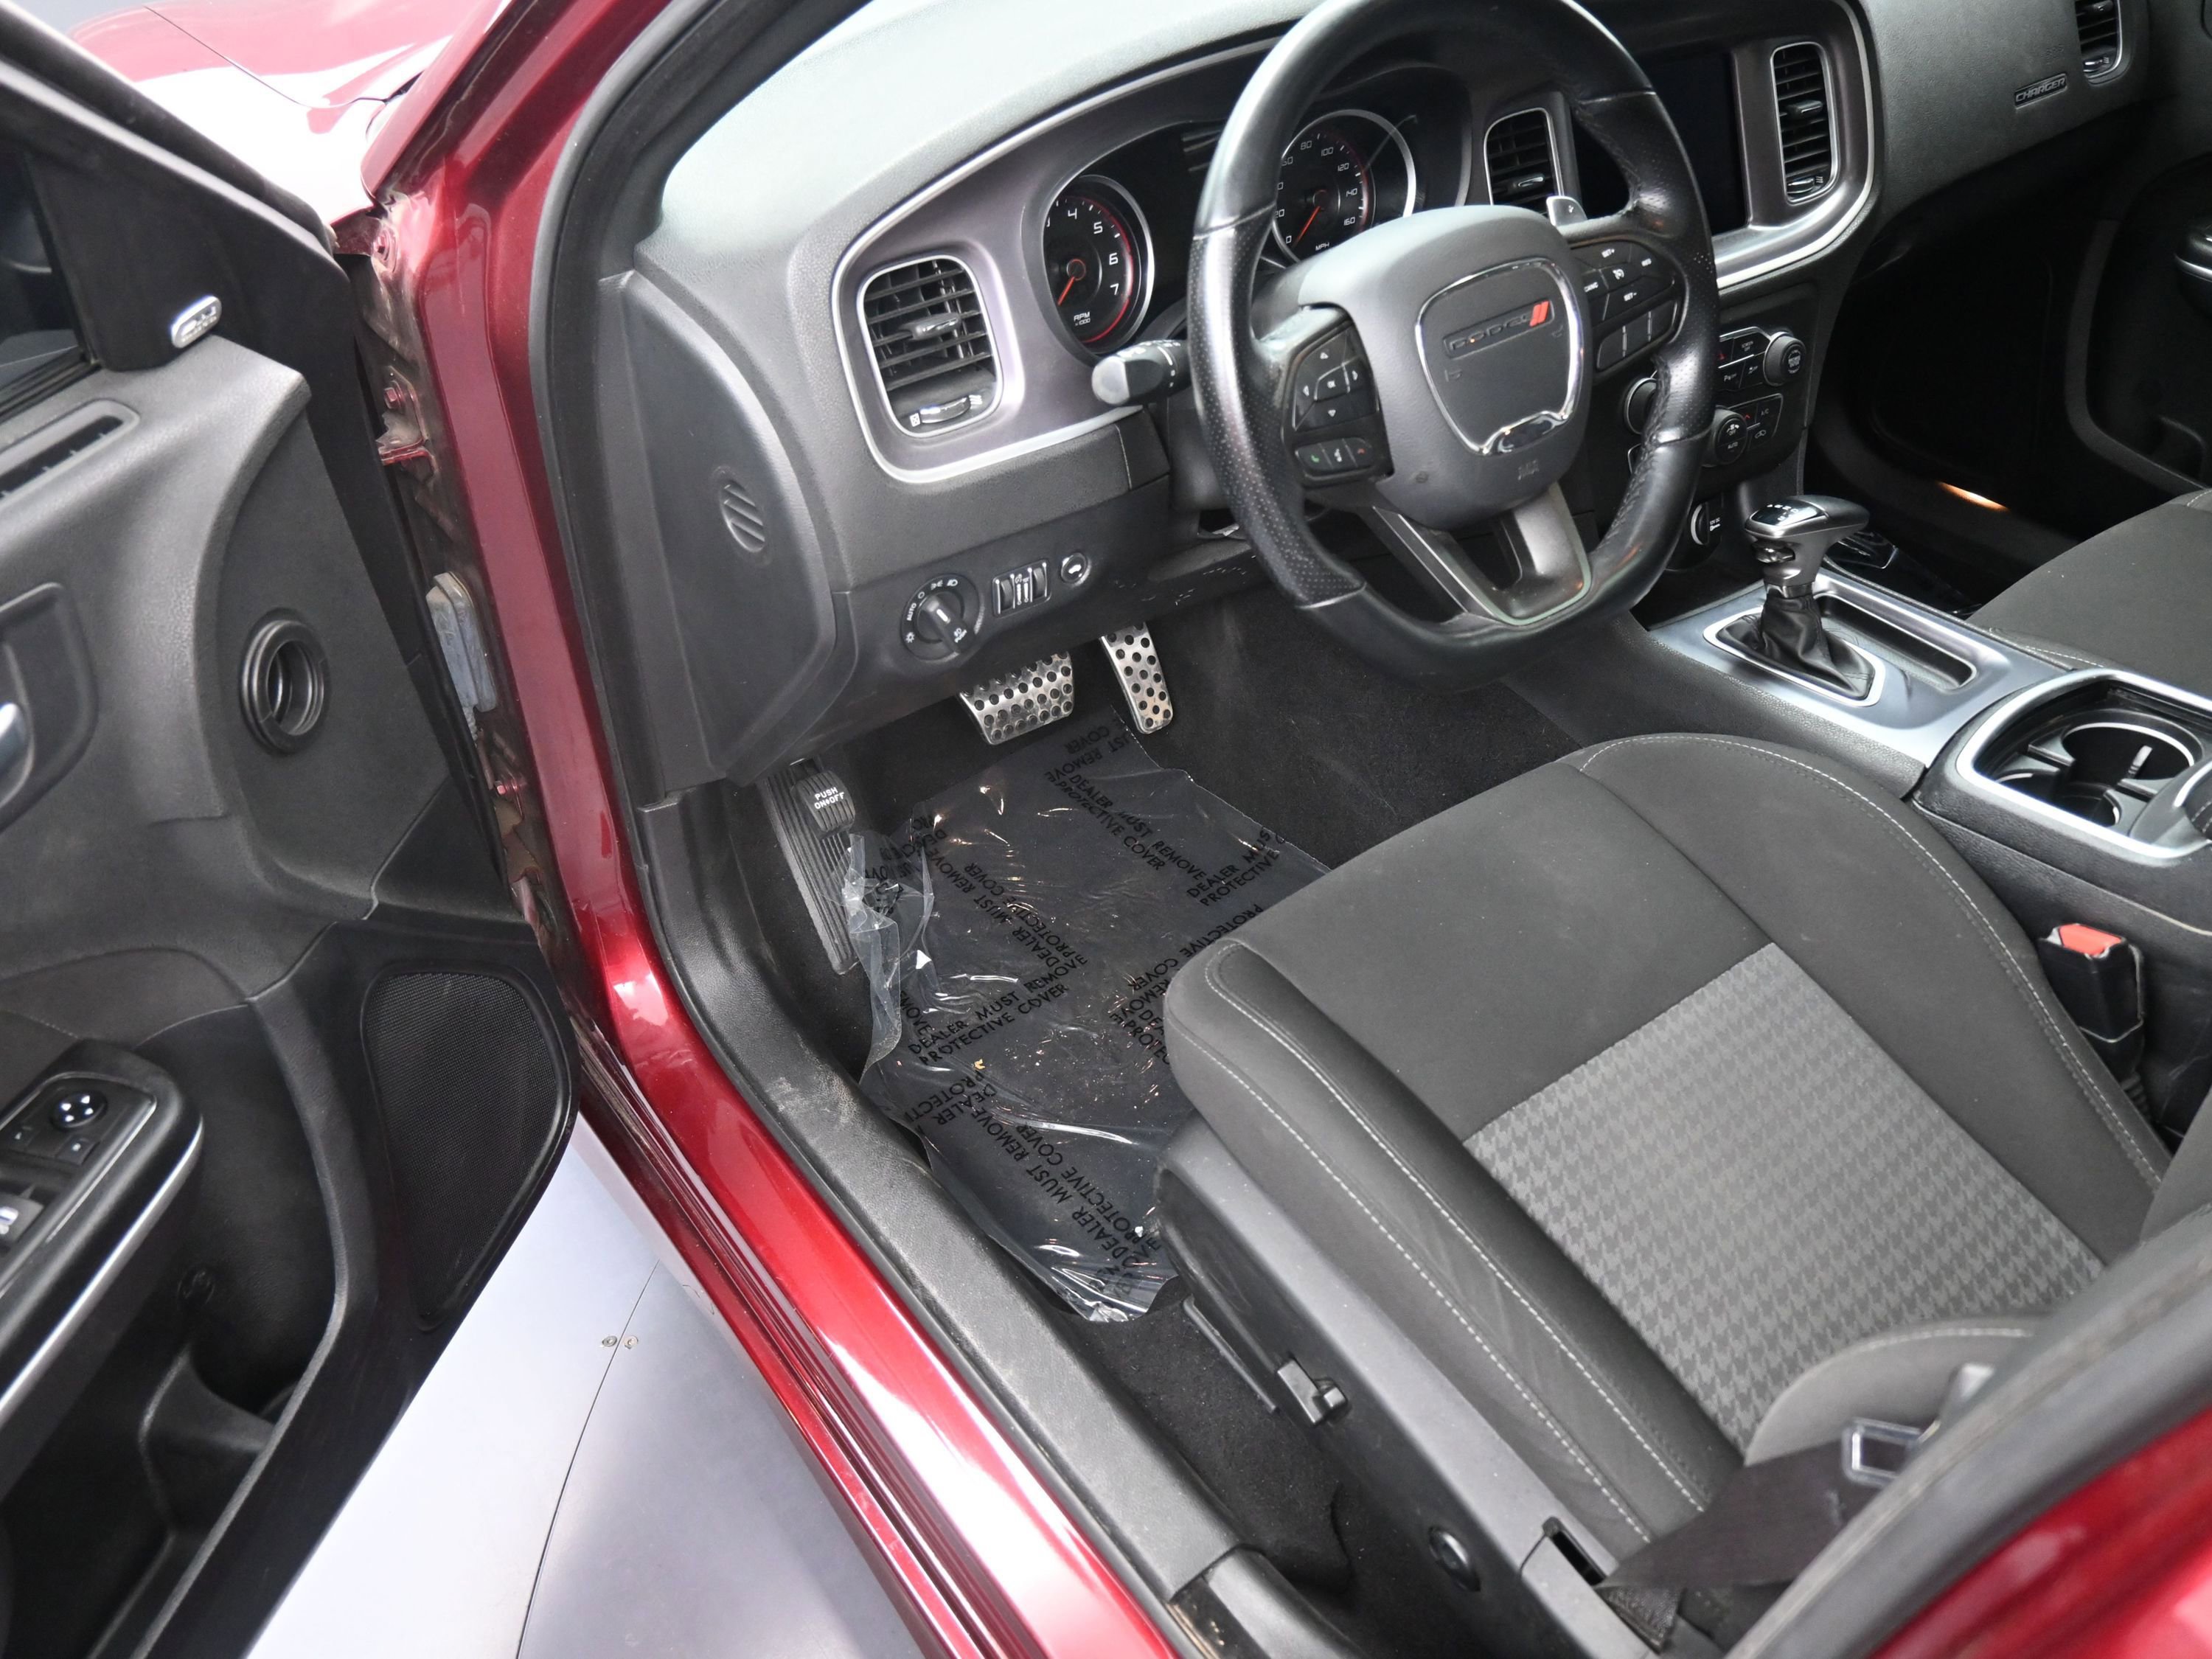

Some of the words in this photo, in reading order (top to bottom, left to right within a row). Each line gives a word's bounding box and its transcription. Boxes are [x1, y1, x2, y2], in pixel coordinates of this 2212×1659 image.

[2015, 77, 2066, 102] CHARGER
[1300, 140, 1312, 150] 80
[1321, 147, 1334, 157] 100
[1338, 162, 1350, 172] 120
[1346, 188, 1358, 198] 140
[1068, 208, 1077, 220] 4
[1093, 221, 1103, 234] 5
[1343, 217, 1356, 226] 160
[1286, 235, 1293, 244] 0
[1315, 242, 1330, 251] MPH
[1109, 252, 1119, 265] 6
[1110, 282, 1119, 295] 7
[1074, 311, 1091, 321] RPM
[906, 602, 917, 622] AUTO
[1064, 725, 1110, 755] COVER
[814, 787, 838, 801] PUSH
[1054, 779, 1125, 836] PROTECTIVE
[1123, 835, 1166, 871] COVER
[1069, 773, 1114, 809] DEALER
[1116, 810, 1153, 838] MUST
[1151, 839, 1208, 881] REMOVE
[964, 862, 1005, 897] COVER
[1186, 864, 1240, 898] DEALER
[1199, 849, 1280, 906] PROTECTIVE
[973, 894, 1015, 924] MUST
[1012, 926, 1061, 968] DEALER
[1127, 958, 1179, 991] COVER
[908, 1019, 969, 1056] DEALER
[974, 990, 1021, 1022] MUST
[1023, 956, 1089, 994] REMOVE
[918, 1011, 1016, 1067] PROTECTIVE
[1017, 982, 1070, 1015] COVER
[931, 1083, 998, 1126] DEALER
[970, 1107, 1031, 1162] REMOVE
[1015, 1124, 1064, 1166] COVER
[1026, 1164, 1073, 1204] MUST
[1071, 1206, 1129, 1259] DEALER
